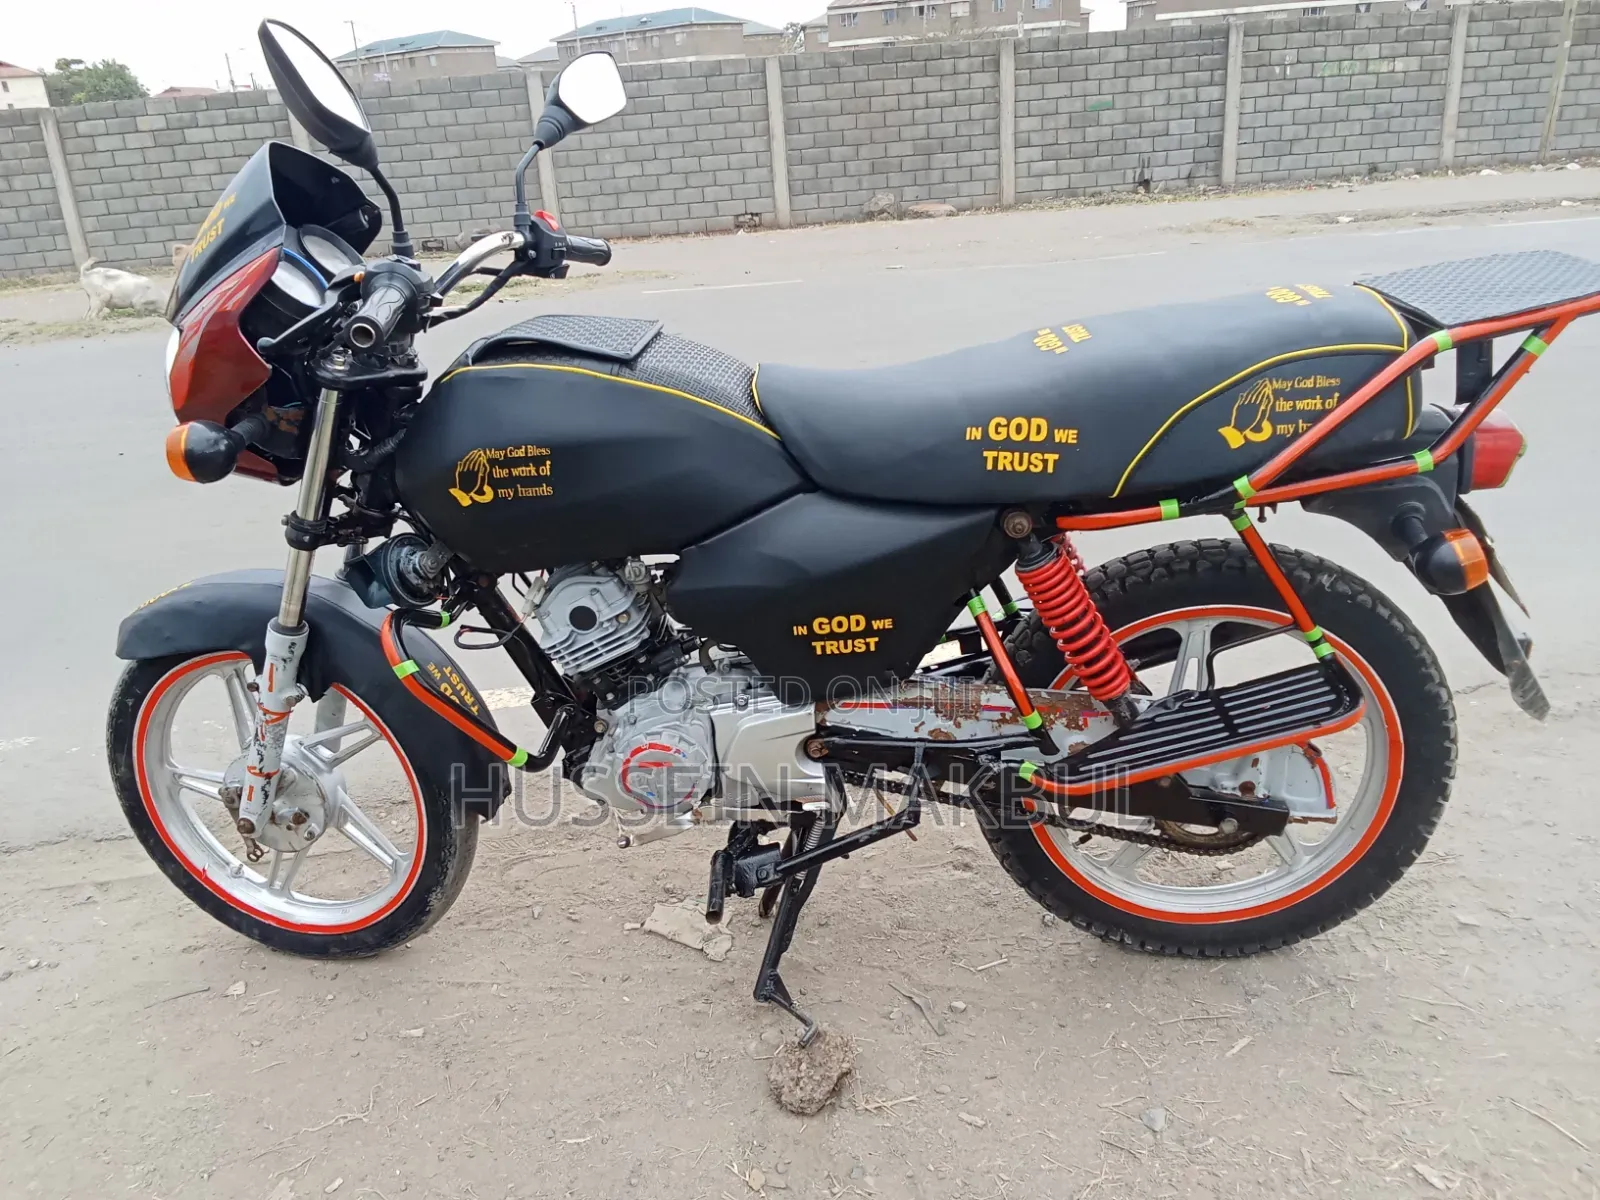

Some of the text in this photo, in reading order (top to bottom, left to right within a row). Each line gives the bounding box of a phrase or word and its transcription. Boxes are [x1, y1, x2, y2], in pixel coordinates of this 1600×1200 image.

[190, 217, 225, 264] TRUST
[1272, 374, 1341, 391] May God Bless
[1275, 392, 1340, 412] the work of
[965, 416, 1078, 444] IN GOD WE
[1276, 423, 1295, 437] my
[485, 445, 551, 461] May God Bless
[983, 450, 1060, 474] TRUST
[492, 460, 551, 478] the work of
[497, 482, 553, 500] my hands
[792, 614, 893, 636] IN GOD WE
[811, 636, 880, 655] TRUST
[427, 661, 441, 680] WE
[443, 665, 479, 716] TRUST
